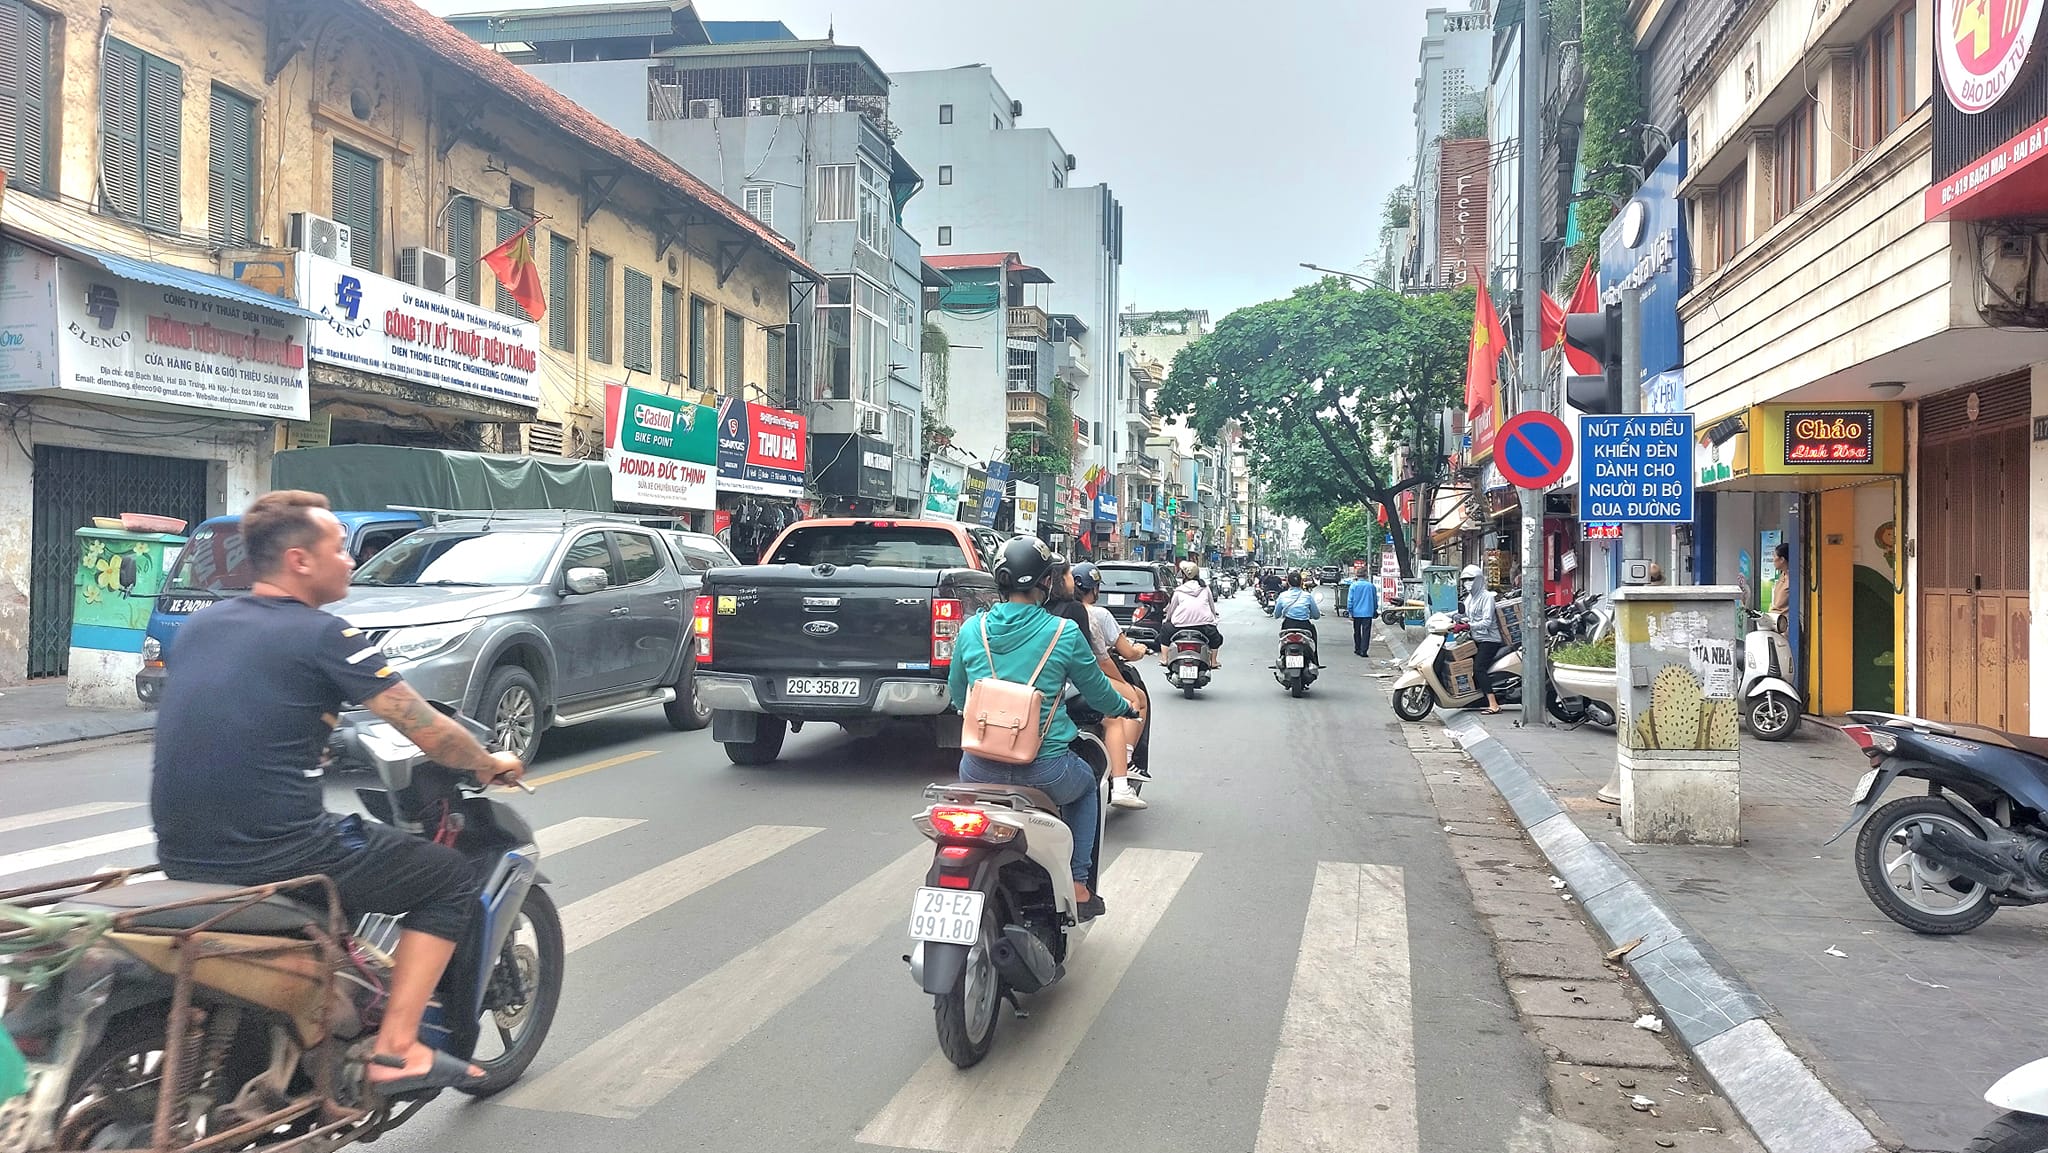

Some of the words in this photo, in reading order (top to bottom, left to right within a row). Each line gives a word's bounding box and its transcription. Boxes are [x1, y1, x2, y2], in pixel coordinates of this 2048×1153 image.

[1985, 66, 2007, 100] DUY
[1969, 162, 1990, 191] BẠCH
[1991, 152, 2007, 176] MAI
[2013, 139, 2028, 164] HAI
[2030, 128, 2042, 154] BÀ
[163, 293, 186, 308] CÔNG
[189, 299, 199, 309] TY
[262, 314, 285, 328] THÔNG
[320, 304, 371, 338] ELENCO
[415, 298, 430, 310] BAN
[430, 301, 450, 316] NHÂN
[466, 311, 488, 326] THÀNH
[67, 320, 131, 350] ELENCO
[385, 307, 416, 342] CÔNG
[418, 318, 432, 345] TY
[451, 328, 482, 360] THUẬT
[508, 340, 537, 373] THÔNG
[145, 353, 164, 367] CỬA
[167, 357, 192, 371] HÀNG
[194, 360, 213, 374] BÁN
[215, 366, 221, 376] &
[239, 370, 262, 384] THIỆU
[391, 345, 408, 359] DIEN
[410, 348, 433, 363] THONG
[433, 355, 461, 371] ELECTRIC
[462, 362, 500, 380] ENGINEERING
[500, 372, 529, 387] COMPANY
[644, 408, 671, 429] Castrol
[1588, 419, 1619, 437] NÚT
[1623, 418, 1646, 437] ẤN
[1649, 418, 1684, 437] ĐIỀU
[1796, 419, 1862, 439] Cháo
[635, 432, 652, 444] BIKE
[653, 435, 674, 448] POINT
[758, 432, 780, 458] THU
[782, 432, 798, 461] HÀ
[1594, 438, 1640, 458] KHIỂN
[1646, 440, 1678, 458] ĐÈN
[1791, 444, 1829, 458] Linh
[1833, 444, 1866, 458] Hoa
[619, 457, 655, 477] HONDA
[657, 461, 678, 480] ĐỨC
[680, 467, 706, 487] THỊNH
[1596, 460, 1638, 477] DÀNH
[1643, 463, 1675, 477] CHO
[1589, 480, 1636, 497] NGƯỜI
[1642, 483, 1657, 497] ĐI
[1662, 480, 1682, 499] BỘ
[1591, 502, 1623, 516] QUA
[1627, 499, 1681, 516] ĐƯỜNG
[170, 600, 182, 612] XE
[810, 623, 830, 633] Ford
[787, 678, 858, 696] 29C-358.72
[924, 892, 972, 917] 29-E2
[914, 915, 974, 940] 991.80
